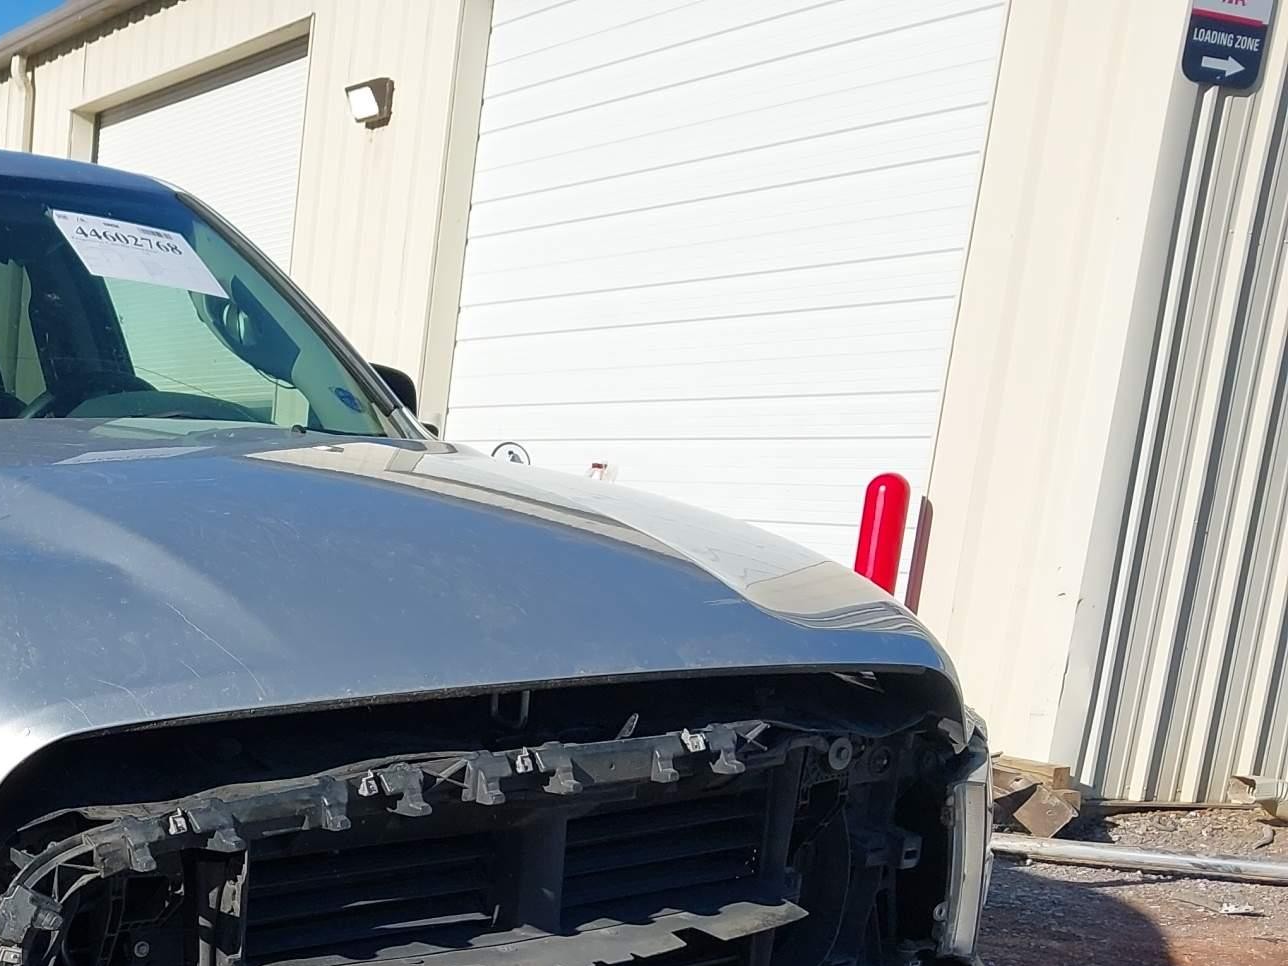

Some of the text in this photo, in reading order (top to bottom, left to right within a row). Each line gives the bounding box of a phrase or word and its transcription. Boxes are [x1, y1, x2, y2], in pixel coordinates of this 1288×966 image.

[1193, 27, 1261, 52] LOADING ZONE
[75, 226, 182, 255] 44602768
